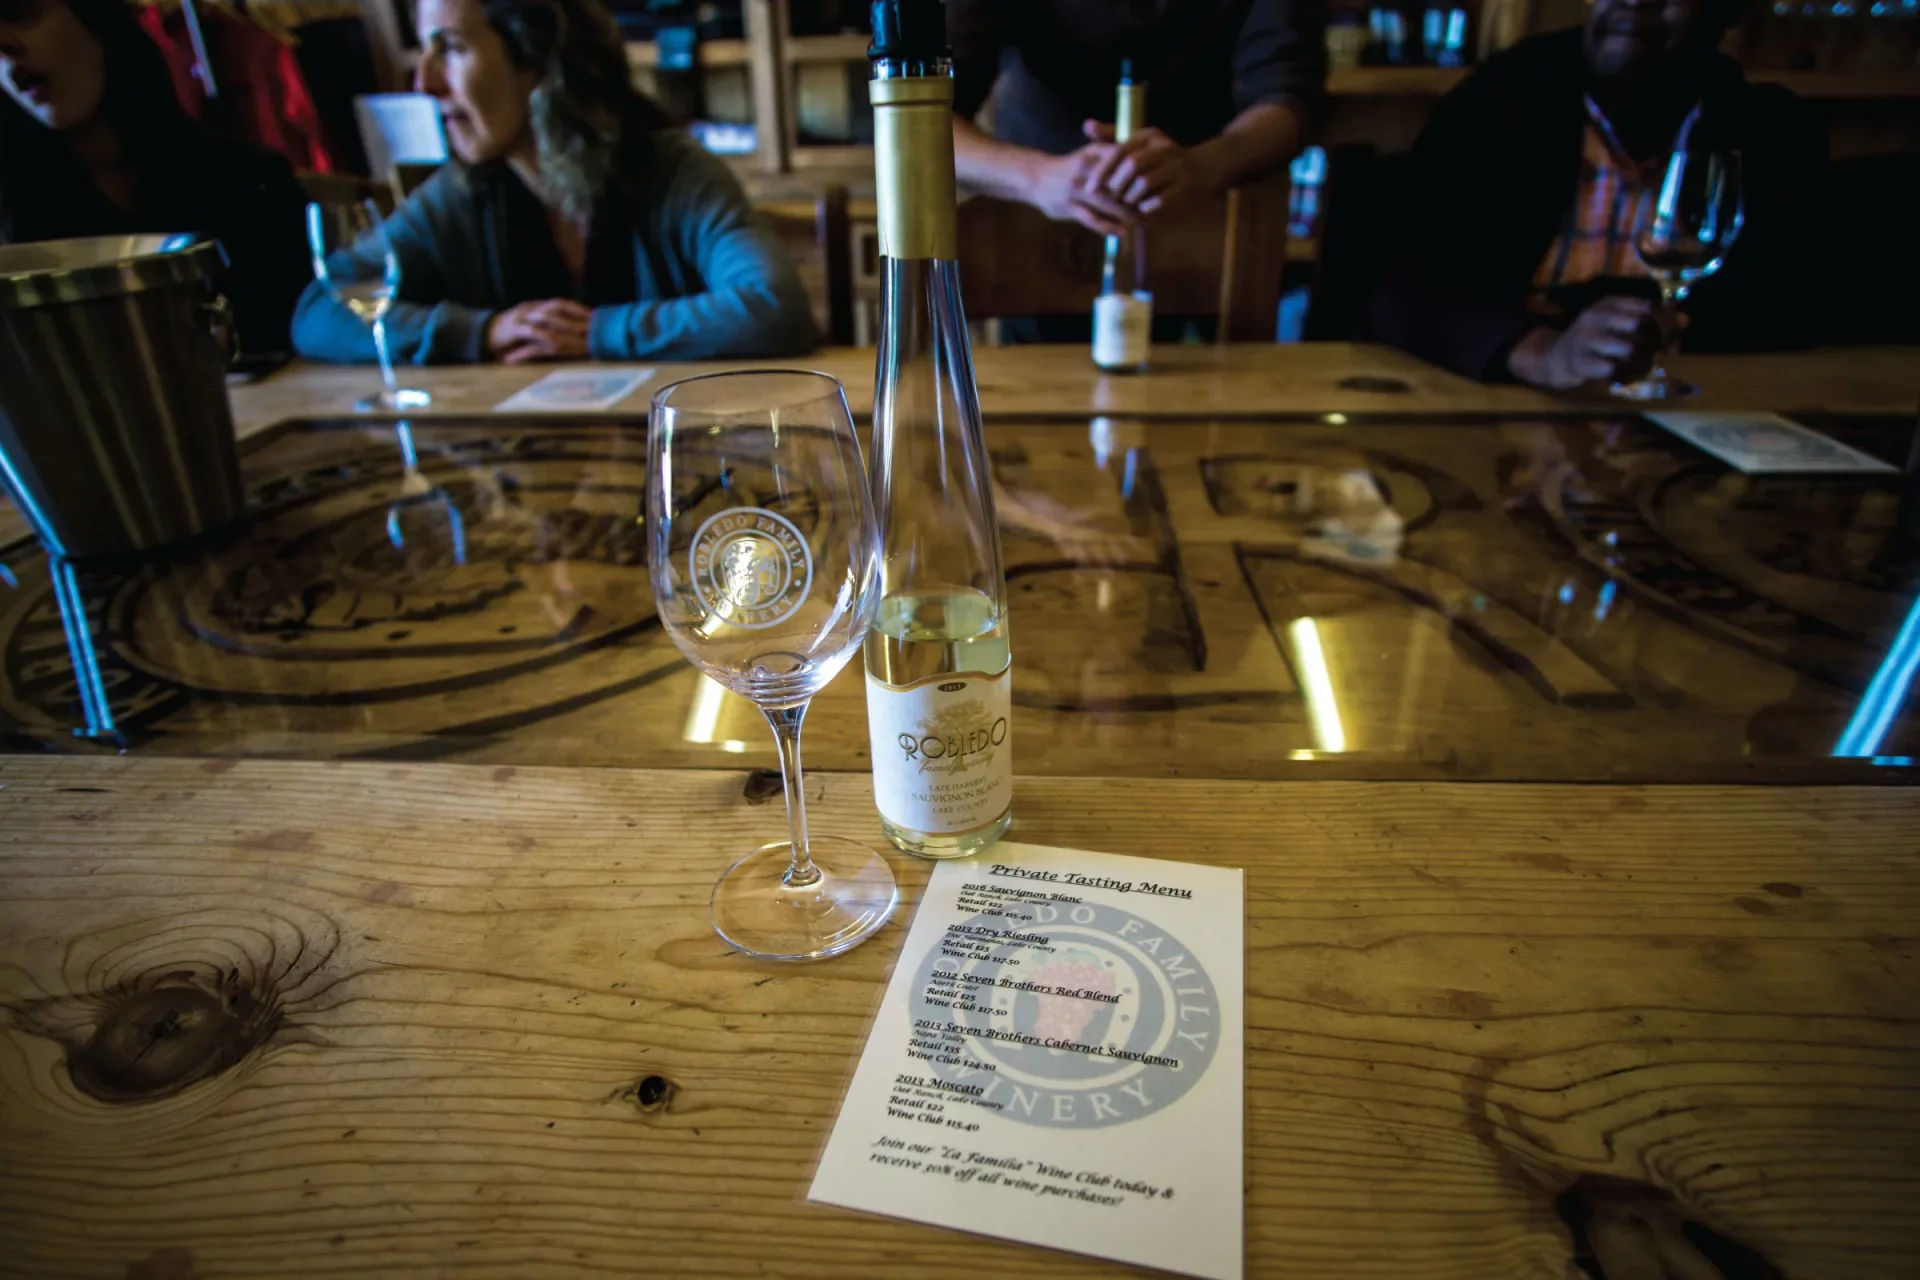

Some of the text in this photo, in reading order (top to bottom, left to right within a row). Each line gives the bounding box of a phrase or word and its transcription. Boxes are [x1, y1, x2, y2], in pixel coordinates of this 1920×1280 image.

[756, 516, 805, 569] FAMILY
[898, 716, 1007, 762] ROBLEDO
[911, 790, 975, 803] SAUVIGNON
[989, 863, 1192, 899] Private Tasting Menu
[958, 897, 987, 906] Retail
[961, 883, 1083, 904] 2016 Sauvignon Blanc
[956, 904, 980, 913] Wine
[981, 908, 1003, 916] Club
[947, 924, 1049, 944] 2013 Dry Riesling
[940, 948, 966, 958] Wine
[967, 952, 990, 961] Club
[943, 940, 990, 953] Retail $25
[926, 987, 976, 1001] Retail $25
[930, 970, 1123, 1004] 2012 Seven Brothers Red Blend
[1117, 919, 1210, 1052] FAMILY
[924, 996, 950, 1007] Wine
[952, 1001, 976, 1012] Club
[909, 1038, 961, 1055] Retail $35
[914, 1019, 1179, 1069] 2013 Seven Brothers Cabernet Sauvignon
[906, 1048, 934, 1061] Wine
[935, 1054, 961, 1065] Club
[895, 1073, 985, 1097] 2013 Moscato
[890, 1095, 945, 1112] Retail $22
[887, 1106, 915, 1120] Wine
[917, 1112, 944, 1124] Club
[869, 1153, 922, 1170] receive
[953, 1167, 981, 1183] off
[977, 1171, 1003, 1184] all
[1003, 1176, 1039, 1192] wine
[872, 1135, 906, 1151] Join
[907, 1143, 934, 1154] our
[1036, 1162, 1073, 1180] Wine
[1075, 1171, 1112, 1187] Club
[1113, 1178, 1159, 1200] today
[1160, 1187, 1175, 1199] &
